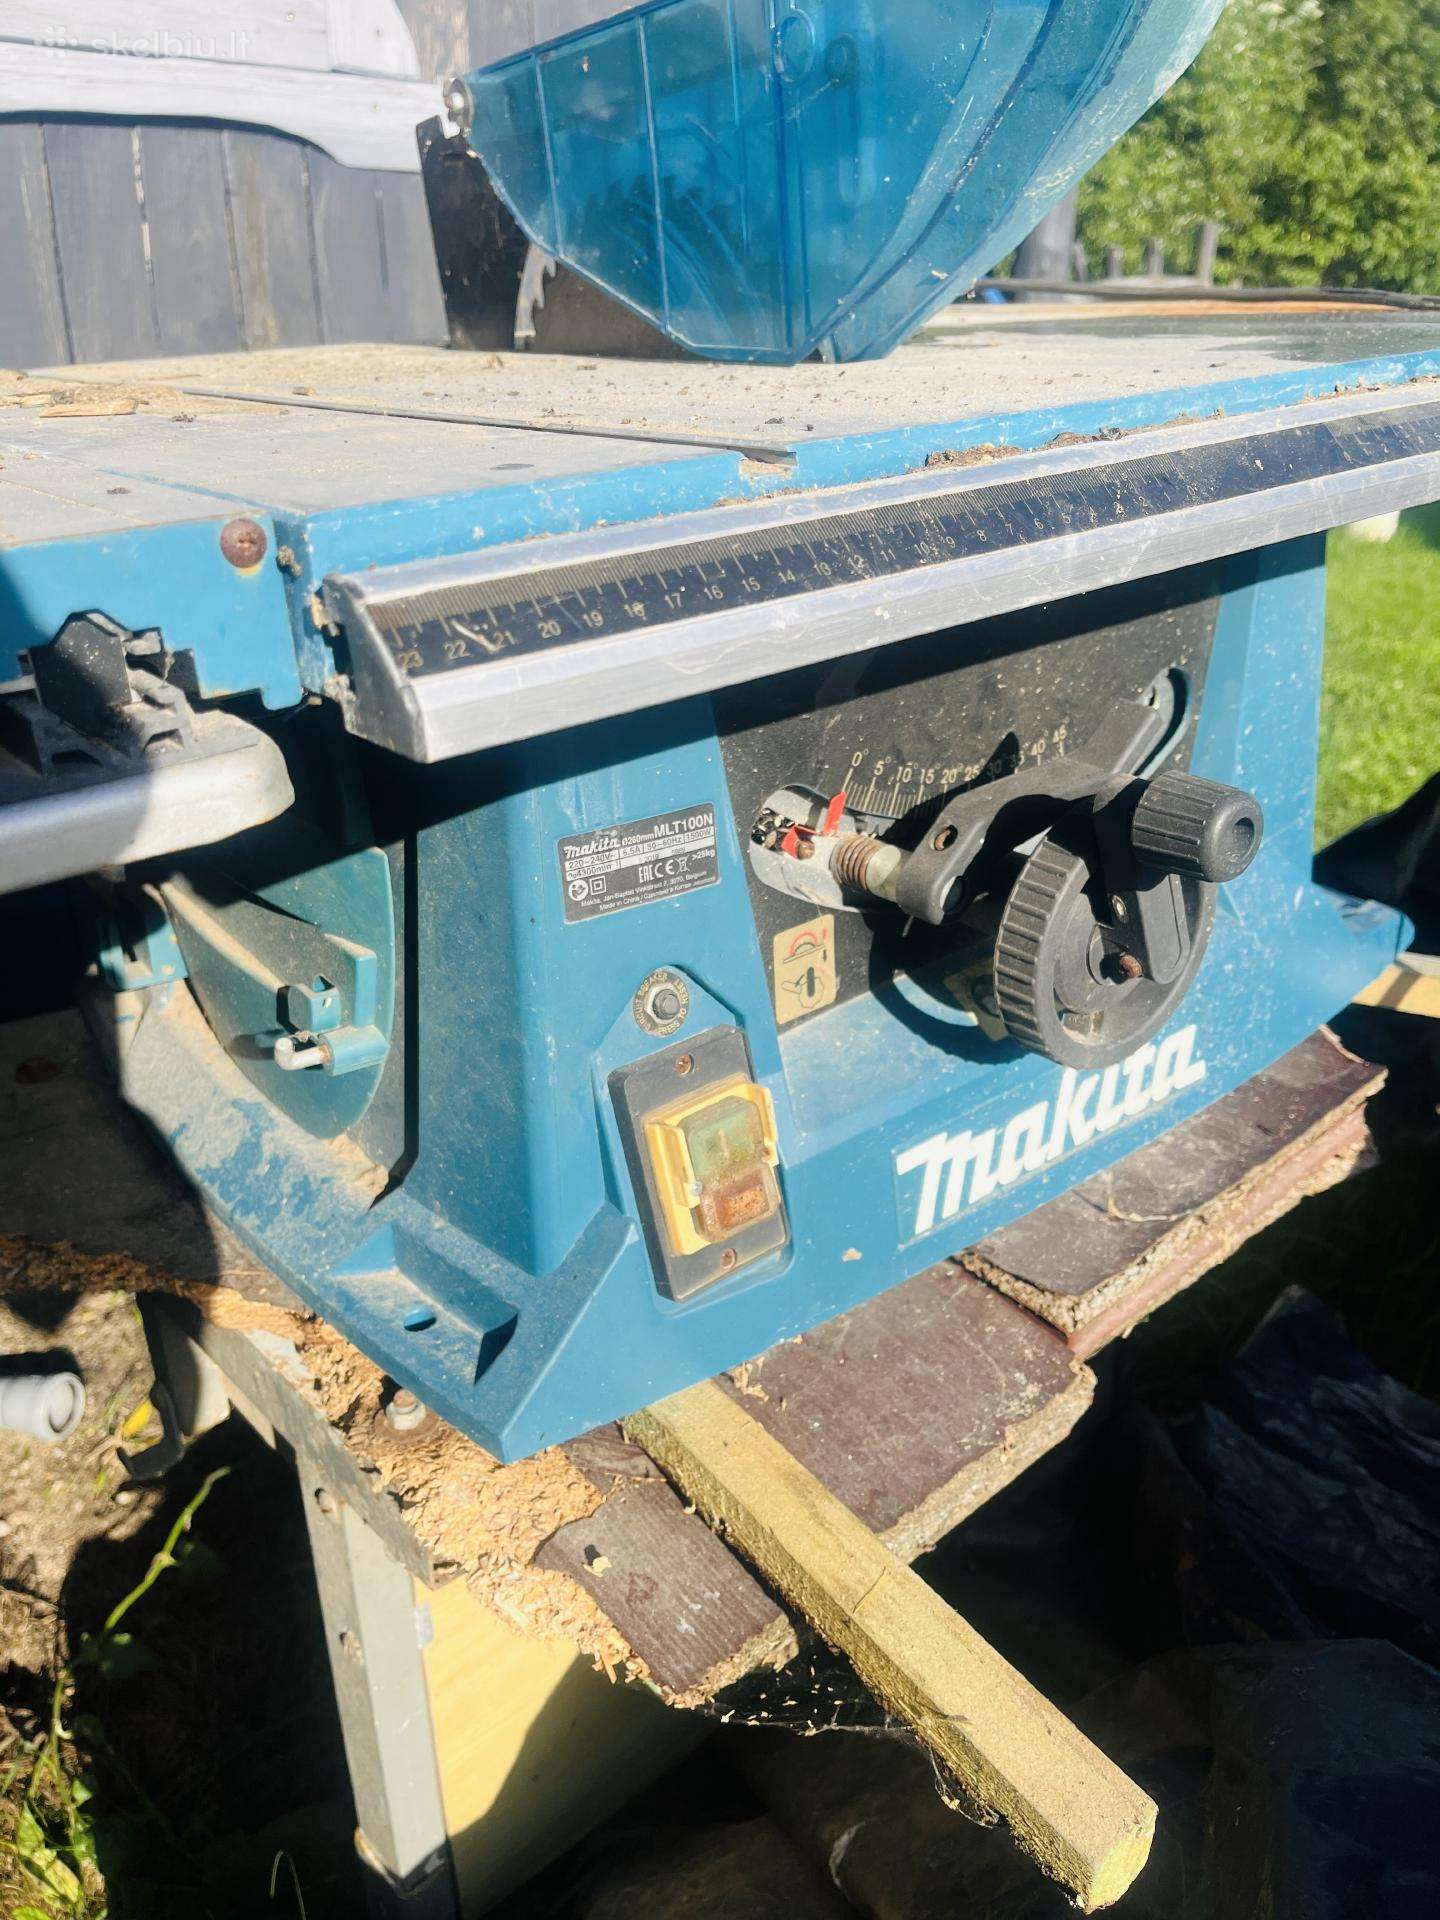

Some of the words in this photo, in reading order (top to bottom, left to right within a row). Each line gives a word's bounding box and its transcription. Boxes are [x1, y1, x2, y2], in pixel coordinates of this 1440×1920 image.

[400, 651, 423, 669] 23
[444, 641, 471, 659] 22
[494, 631, 515, 649] 21
[538, 621, 561, 638] 20
[583, 612, 604, 628] 19
[624, 602, 647, 619] 18
[664, 593, 683, 609] 17
[704, 584, 724, 600] 16
[742, 577, 761, 592] 15
[778, 569, 796, 584] 14
[813, 562, 832, 576] 13
[879, 549, 896, 562] 11
[914, 542, 931, 555] 10
[945, 536, 956, 548] 9
[976, 530, 987, 542] 8
[1005, 523, 1014, 535] 7
[1034, 518, 1044, 529] 6
[1061, 512, 1071, 524] 5
[563, 837, 620, 859] makita
[653, 812, 712, 838] MLT100N
[896, 1024, 1207, 1234] makita
